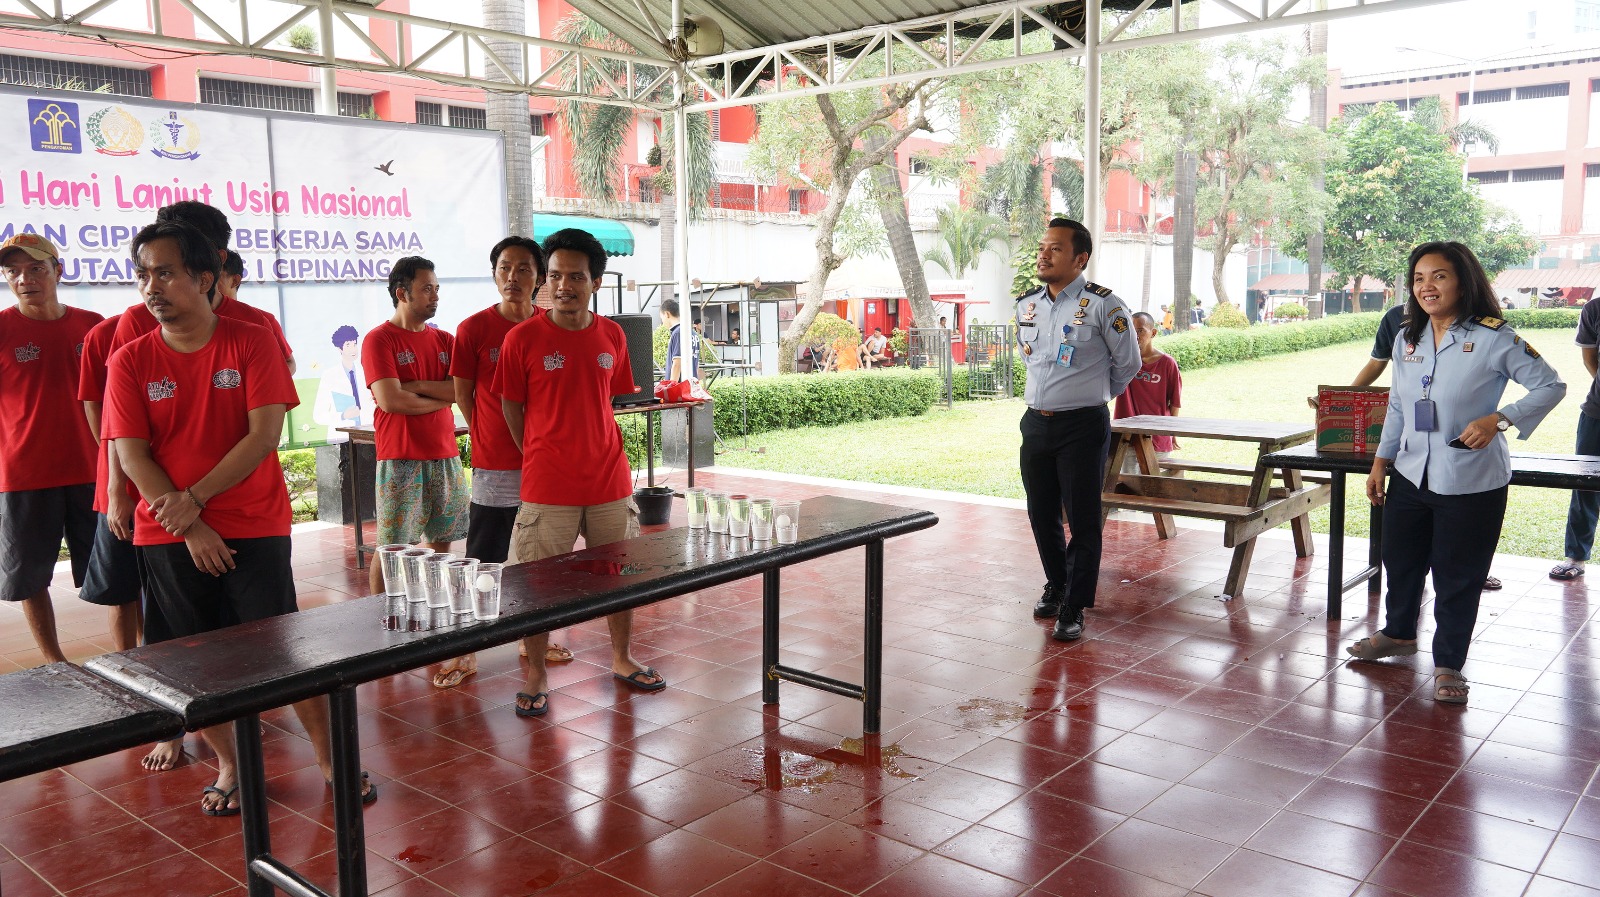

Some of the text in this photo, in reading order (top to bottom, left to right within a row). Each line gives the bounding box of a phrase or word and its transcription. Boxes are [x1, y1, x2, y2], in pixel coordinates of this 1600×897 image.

[20, 169, 101, 208] Hari
[226, 180, 290, 214] Usia
[301, 184, 412, 218] Nasional
[235, 228, 348, 250] BEKERJA
[355, 230, 423, 250] SAMA
[272, 258, 390, 279] CIPINANG
[1338, 433, 1354, 442] Sot
